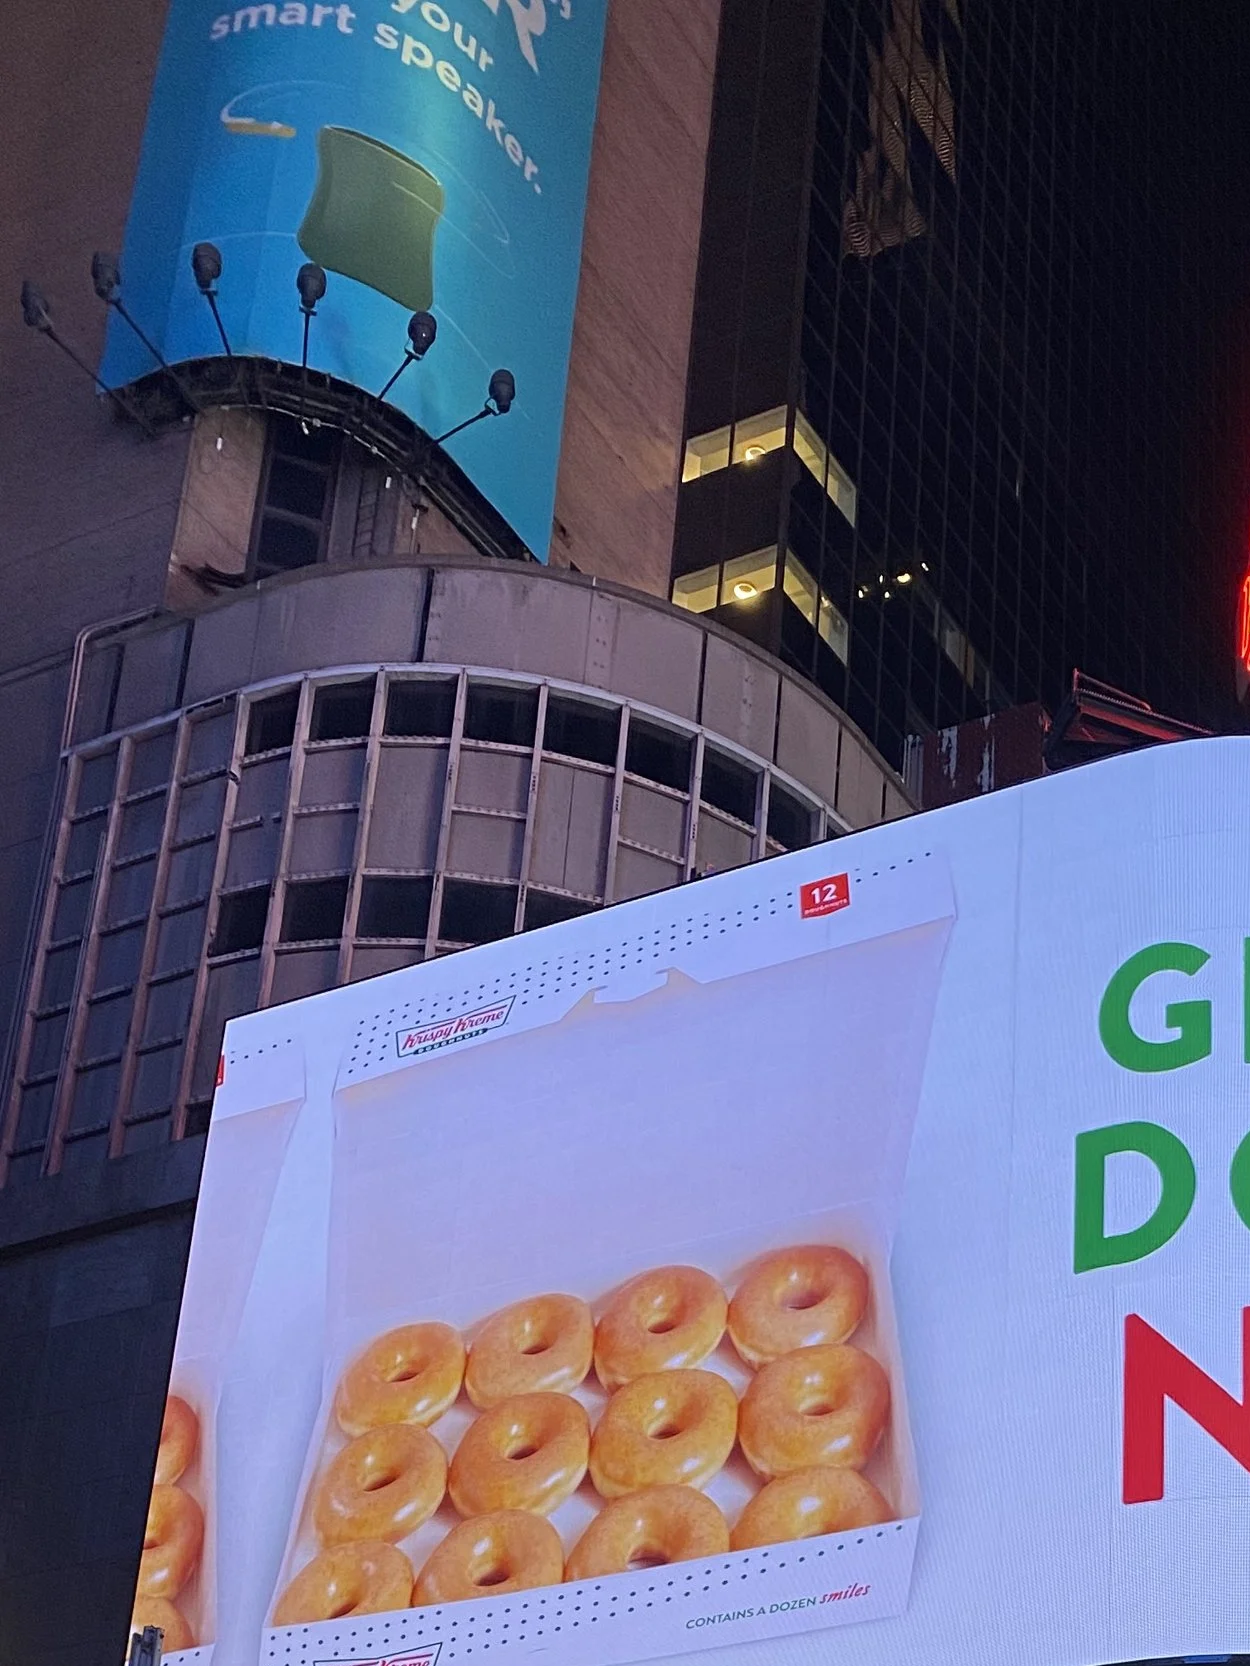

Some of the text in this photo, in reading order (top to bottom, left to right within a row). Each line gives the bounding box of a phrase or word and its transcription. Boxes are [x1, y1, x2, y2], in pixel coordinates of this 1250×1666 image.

[391, 0, 494, 73] your
[209, 2, 357, 41] smart
[373, 22, 543, 196] speaker.
[811, 883, 838, 905] 12
[401, 1004, 509, 1052] Krispy Kreme
[685, 1582, 872, 1630] CONTAINS A DOZEN smiles
